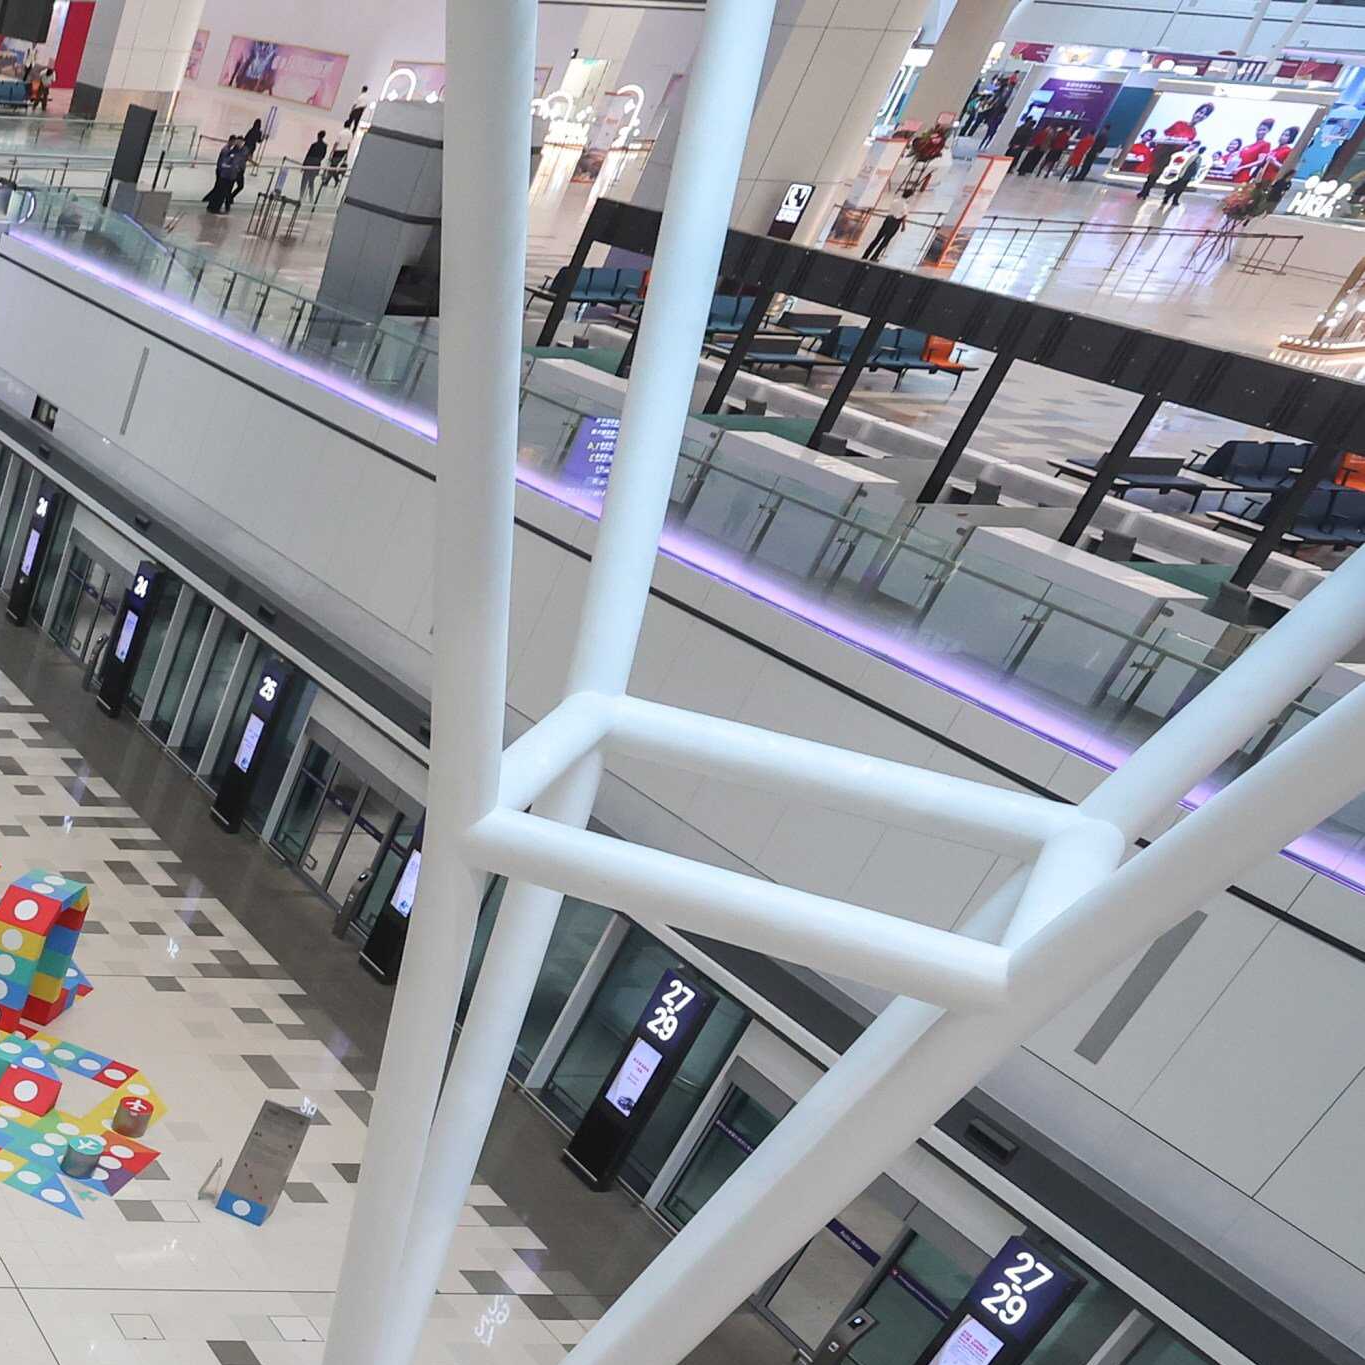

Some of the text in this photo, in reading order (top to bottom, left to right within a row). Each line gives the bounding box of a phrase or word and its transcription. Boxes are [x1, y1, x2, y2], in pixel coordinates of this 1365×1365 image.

[134, 576, 149, 598] 24
[661, 979, 696, 1014] 27
[646, 1007, 679, 1042] 29
[1004, 1252, 1054, 1292] 27
[981, 1282, 1028, 1325] 29
